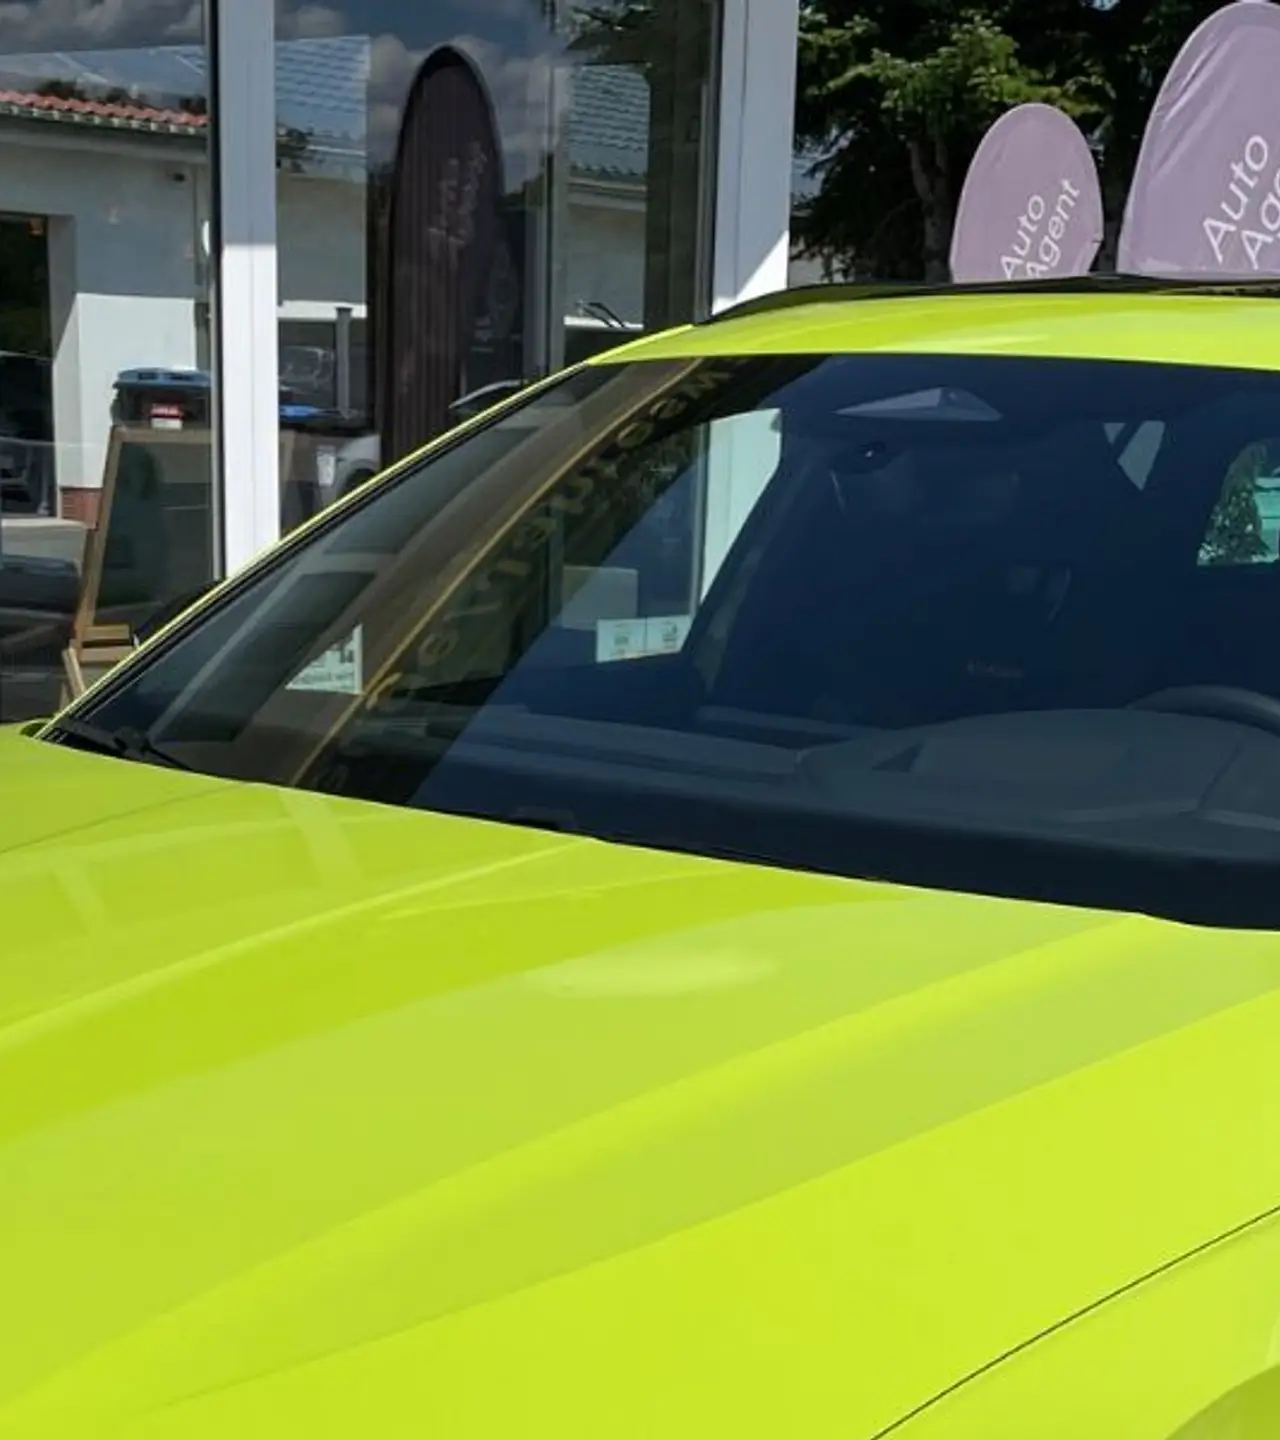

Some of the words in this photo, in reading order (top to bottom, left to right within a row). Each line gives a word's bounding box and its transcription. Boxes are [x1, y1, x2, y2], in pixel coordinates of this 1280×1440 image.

[1001, 194, 1045, 280] Auto
[1026, 178, 1081, 277] Agent
[1202, 135, 1269, 265] Auto
